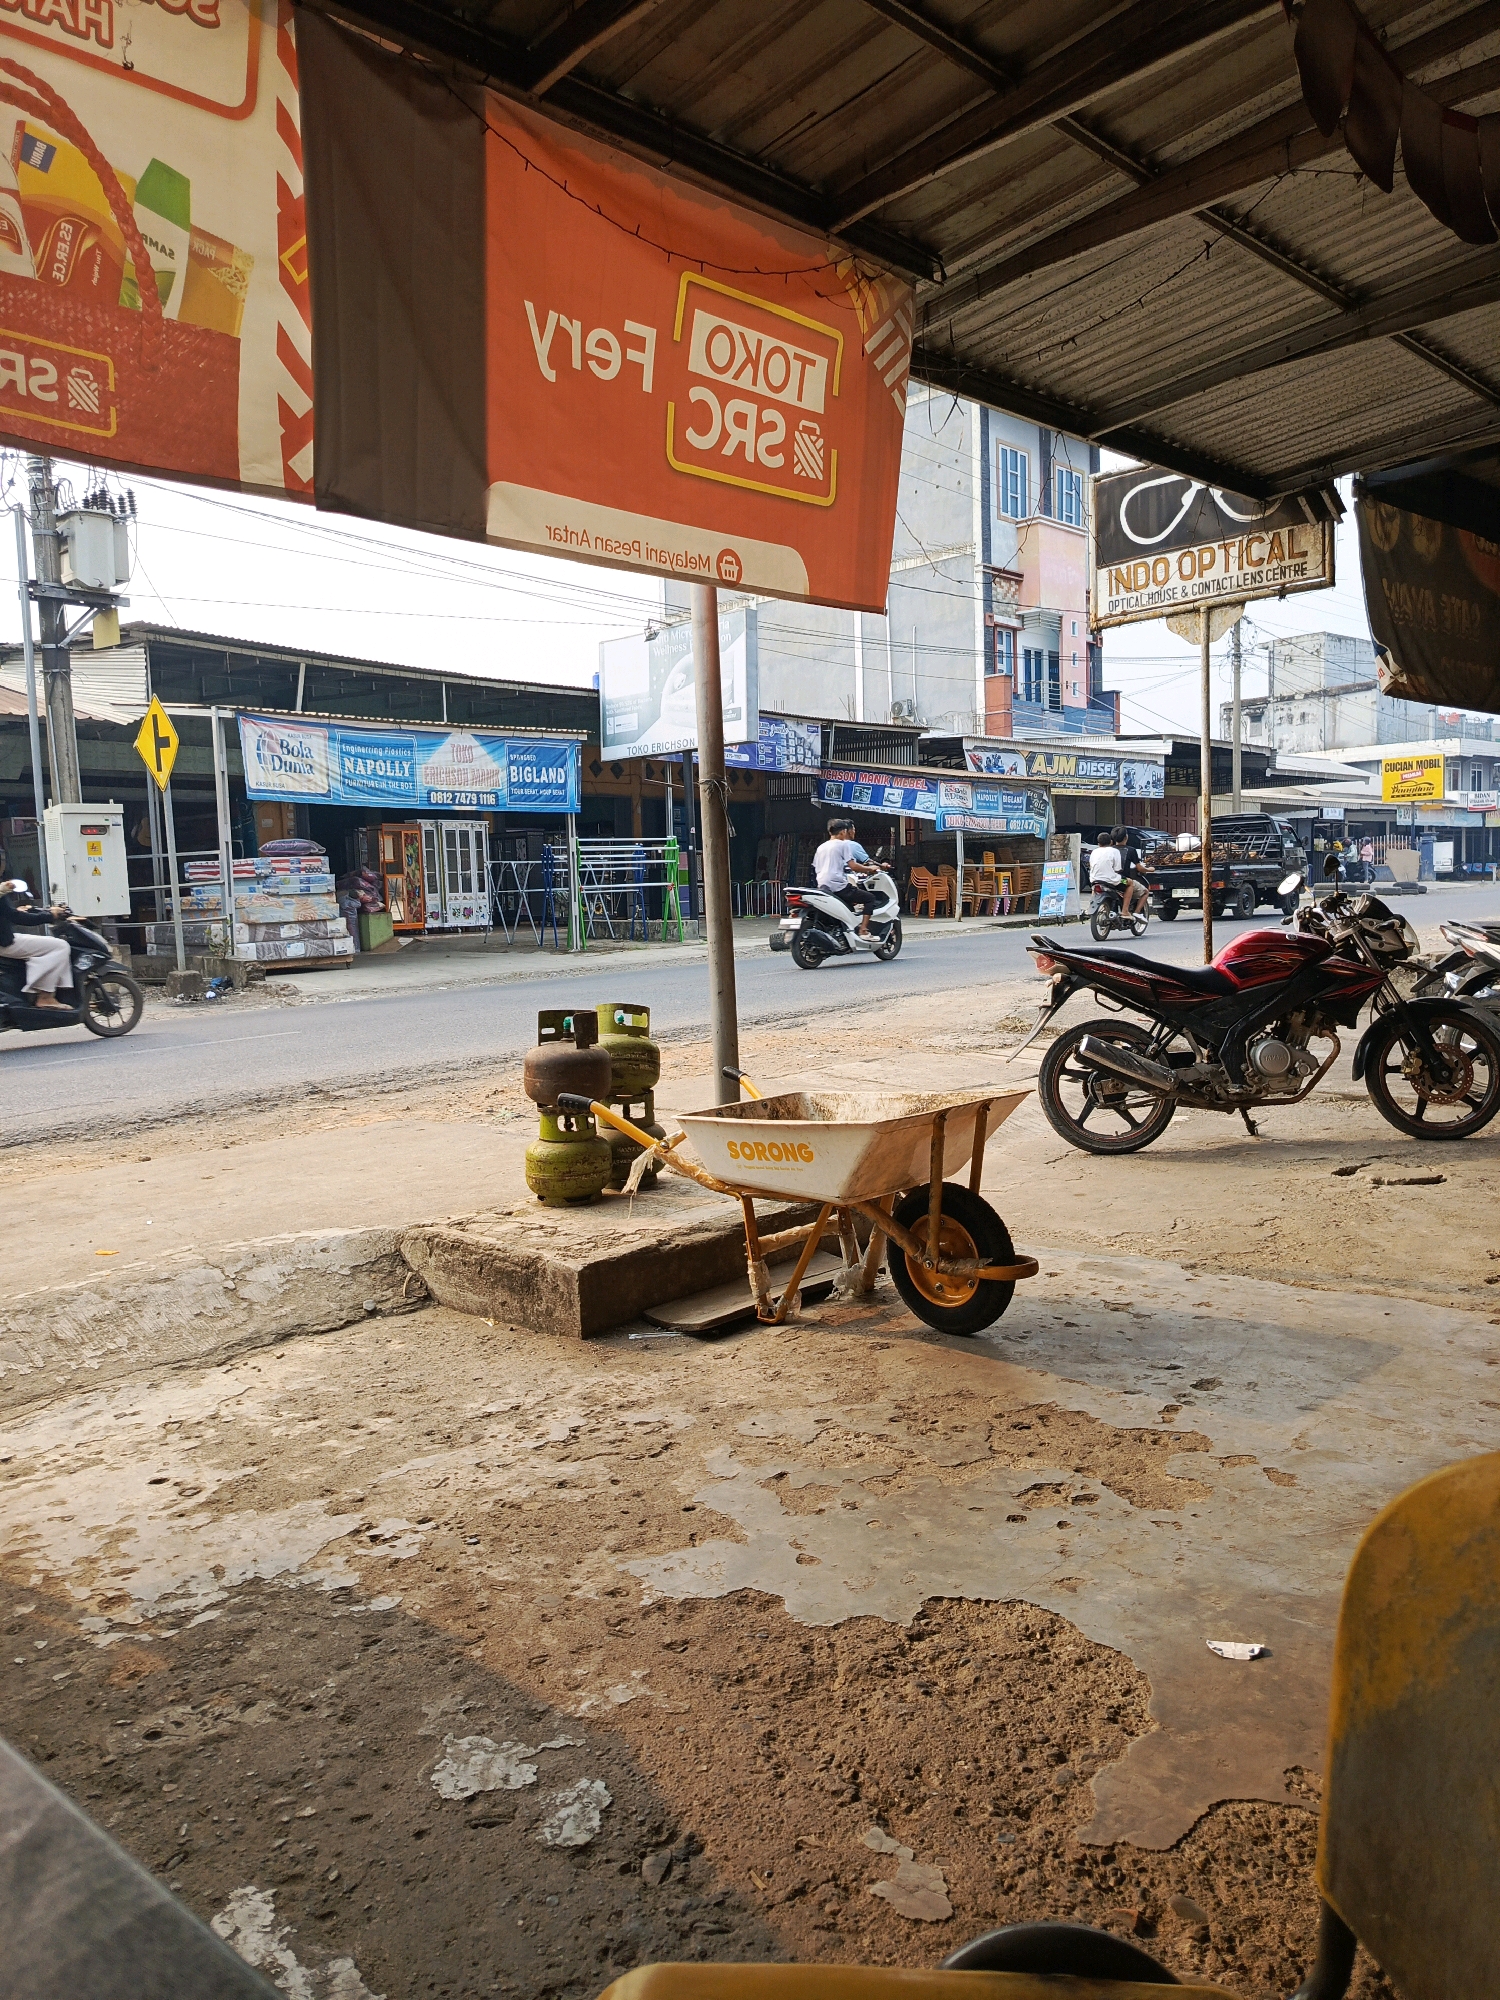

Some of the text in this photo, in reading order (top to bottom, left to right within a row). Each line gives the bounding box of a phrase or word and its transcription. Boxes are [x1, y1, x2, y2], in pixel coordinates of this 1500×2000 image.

[1107, 529, 1309, 597] INDO OPTICAL
[1108, 562, 1308, 613] OPTICAL HOUSE & CONTACT LENS CENTRE
[279, 739, 314, 758] Bola
[450, 743, 474, 763] TOKO
[627, 738, 695, 757] TOKO ERICHSON
[271, 754, 315, 775] Dunia
[344, 757, 411, 777] NAPOLLY
[509, 765, 566, 784] BIGLAND
[1031, 753, 1118, 778] AJM DIESEL
[1384, 758, 1442, 773] CUCIAN MOBIL
[858, 772, 893, 787] MANIK
[892, 778, 928, 791] MEBEL
[430, 791, 496, 805] 0812 7479 1116
[727, 1140, 814, 1163] SORONG
